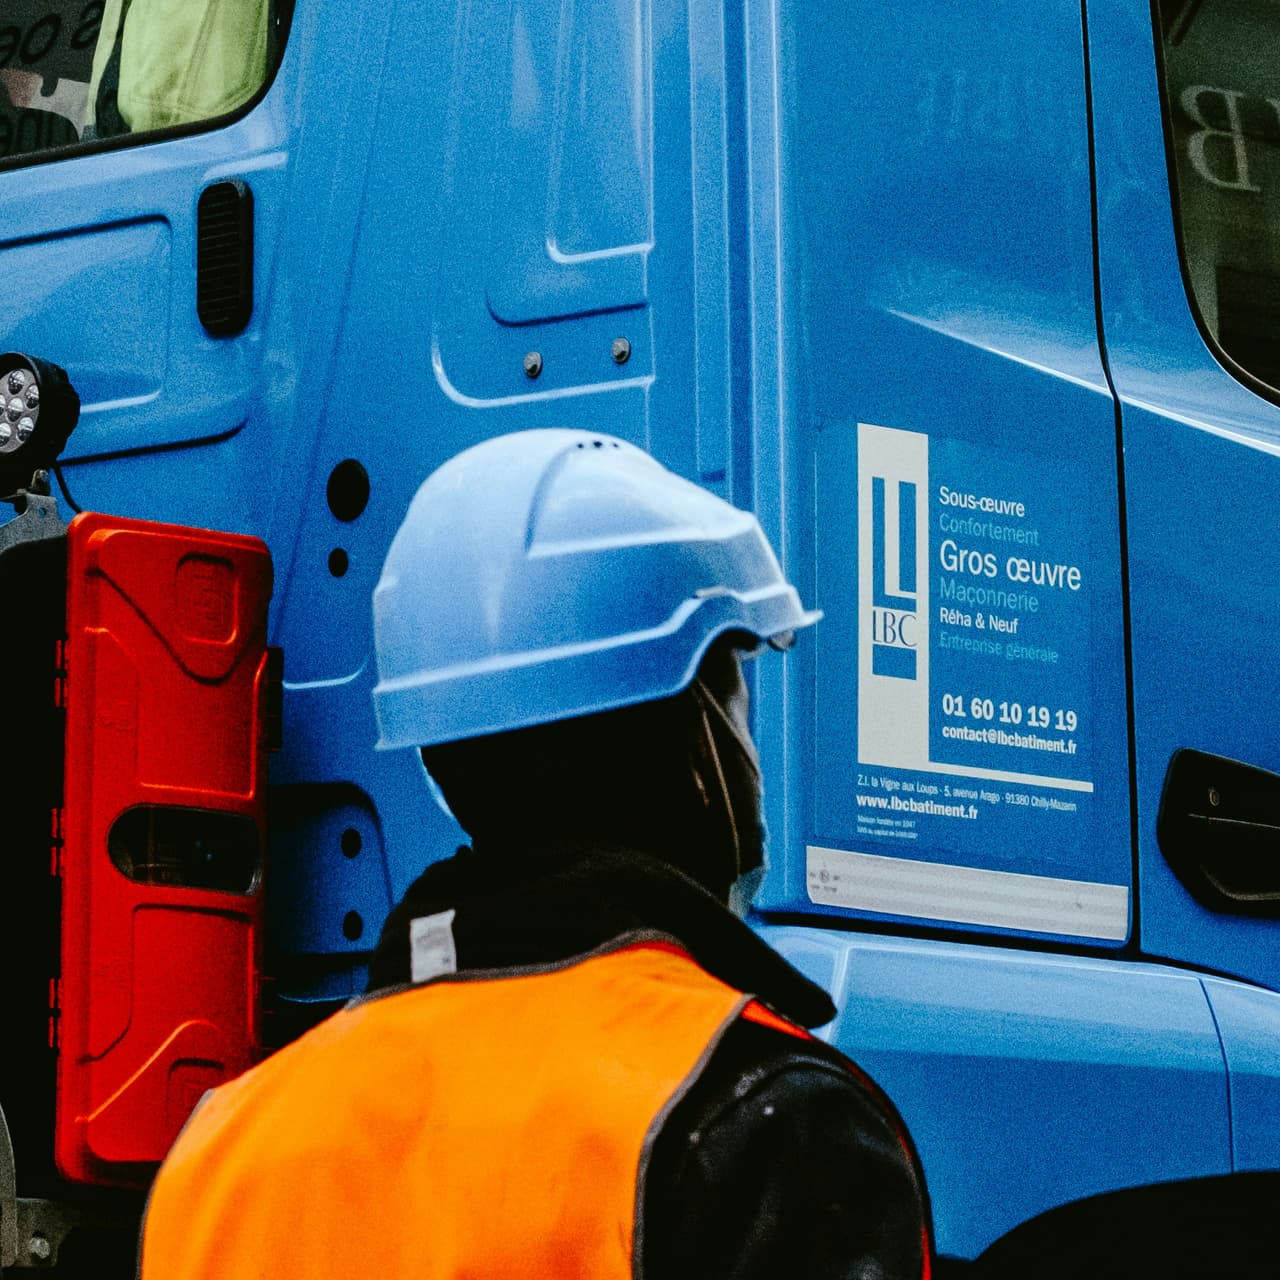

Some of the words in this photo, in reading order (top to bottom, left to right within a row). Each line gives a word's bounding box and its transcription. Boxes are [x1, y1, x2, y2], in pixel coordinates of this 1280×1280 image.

[938, 485, 1025, 518] Sous-œuvre
[939, 512, 1040, 547] Confortement
[939, 538, 998, 578] Gros
[1006, 555, 1082, 591] œuvre
[940, 577, 1039, 613] Maçonnerie
[871, 608, 918, 650] LBC
[939, 606, 972, 628] Réha
[974, 612, 986, 630] &
[988, 614, 1019, 634] Neuf
[939, 631, 1003, 656] Entreprise
[942, 693, 967, 718] 01
[970, 696, 995, 721] 60
[999, 701, 1023, 725] 10
[1026, 705, 1051, 729] 19
[1054, 709, 1078, 733] 19
[941, 725, 1078, 755] contact@lbcbatiment.fr
[880, 777, 901, 792] Vigne
[901, 782, 915, 792] aux
[916, 781, 939, 796] Loups
[855, 794, 979, 820] www.lbcbatiment.fr
